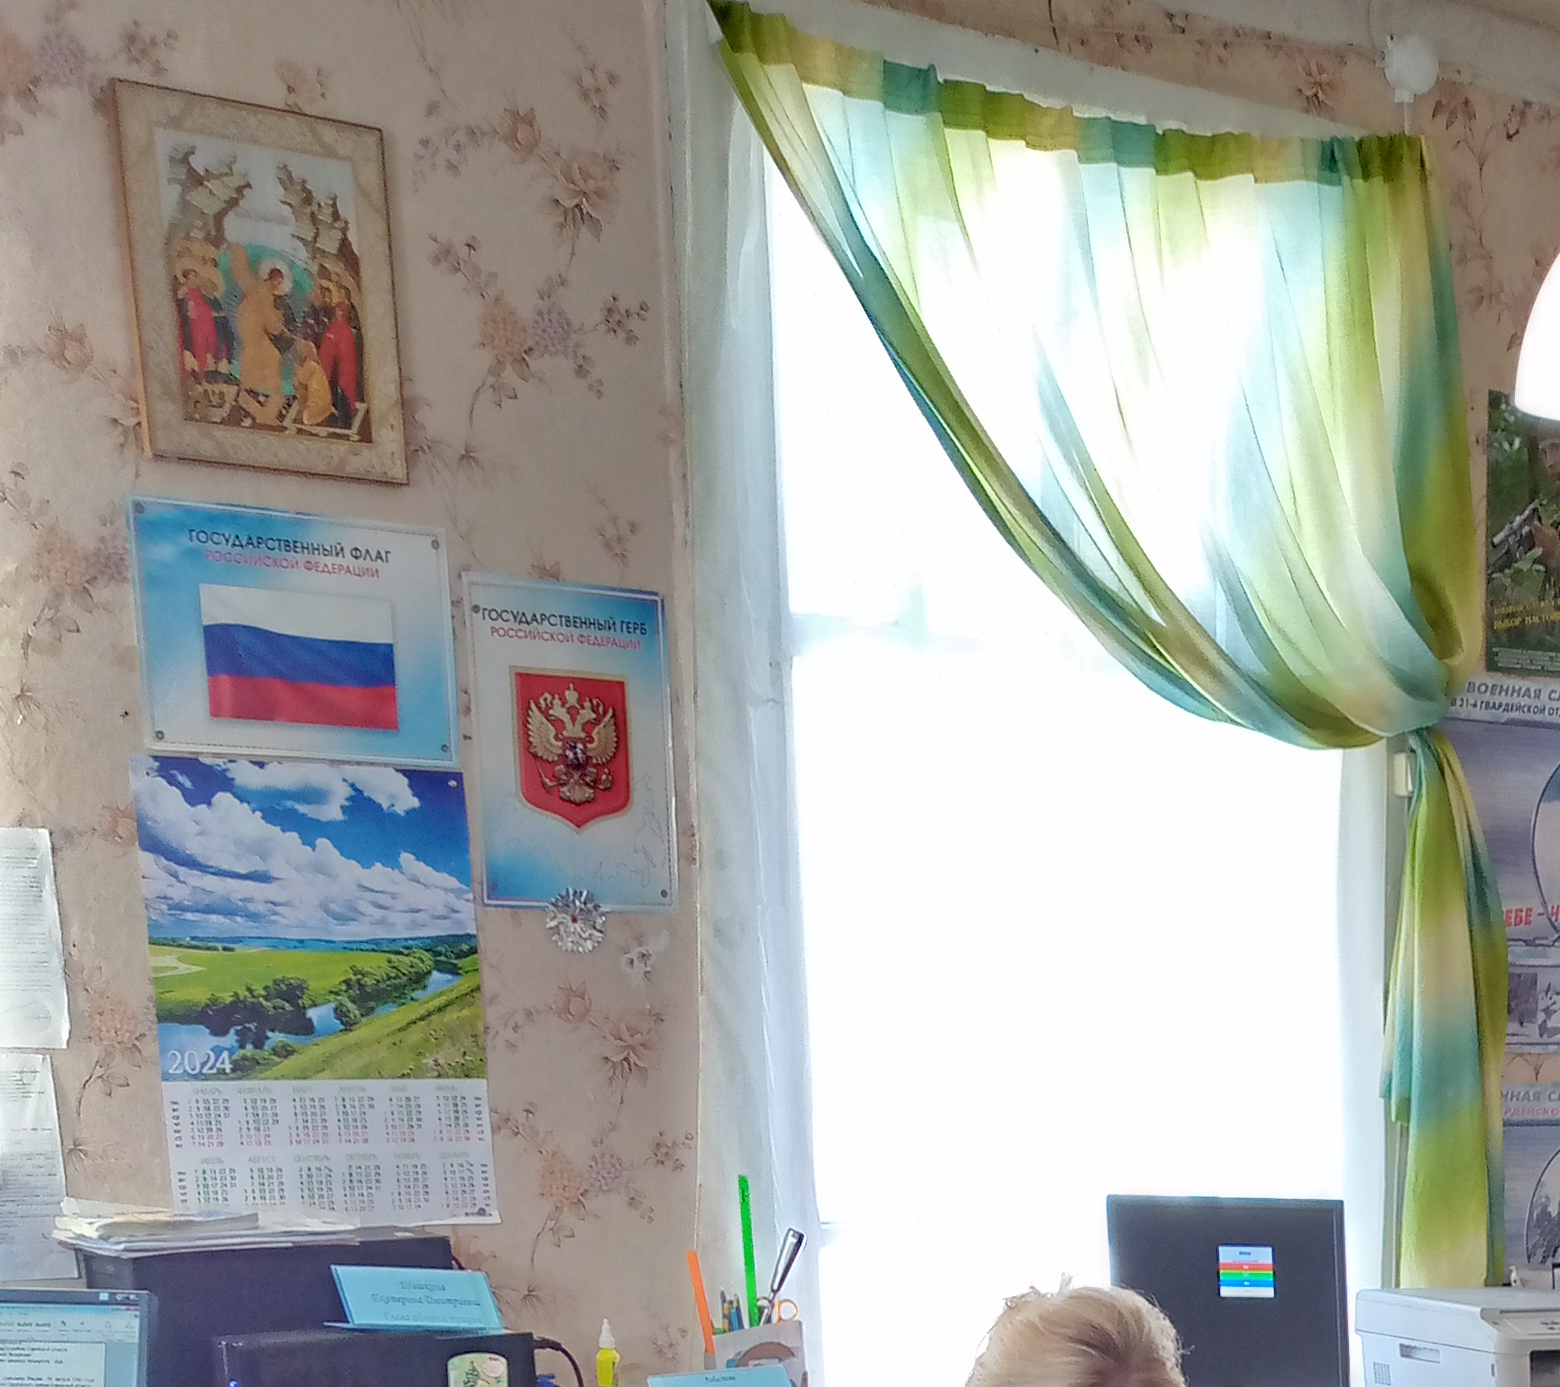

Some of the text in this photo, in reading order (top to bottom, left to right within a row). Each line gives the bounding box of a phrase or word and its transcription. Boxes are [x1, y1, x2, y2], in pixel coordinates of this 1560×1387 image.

[188, 528, 392, 564] ГОСУДАРСТВЕННЫЙ ФЛАГ
[205, 549, 380, 579] РОССИЙСКОЙ ФЕДЕРАЦИИ
[482, 607, 648, 636] ГОСУДАРСТВЕННЫЙ ГЕРБ
[490, 626, 642, 650] РОССИЙСКОЙ ФЕДЕРАЦИИ
[1466, 680, 1542, 702] ВОЕННАЯ
[1504, 907, 1533, 927] ЕБЕ
[167, 1050, 233, 1075] 2024
[1500, 1090, 1541, 1103] ННАЯ
